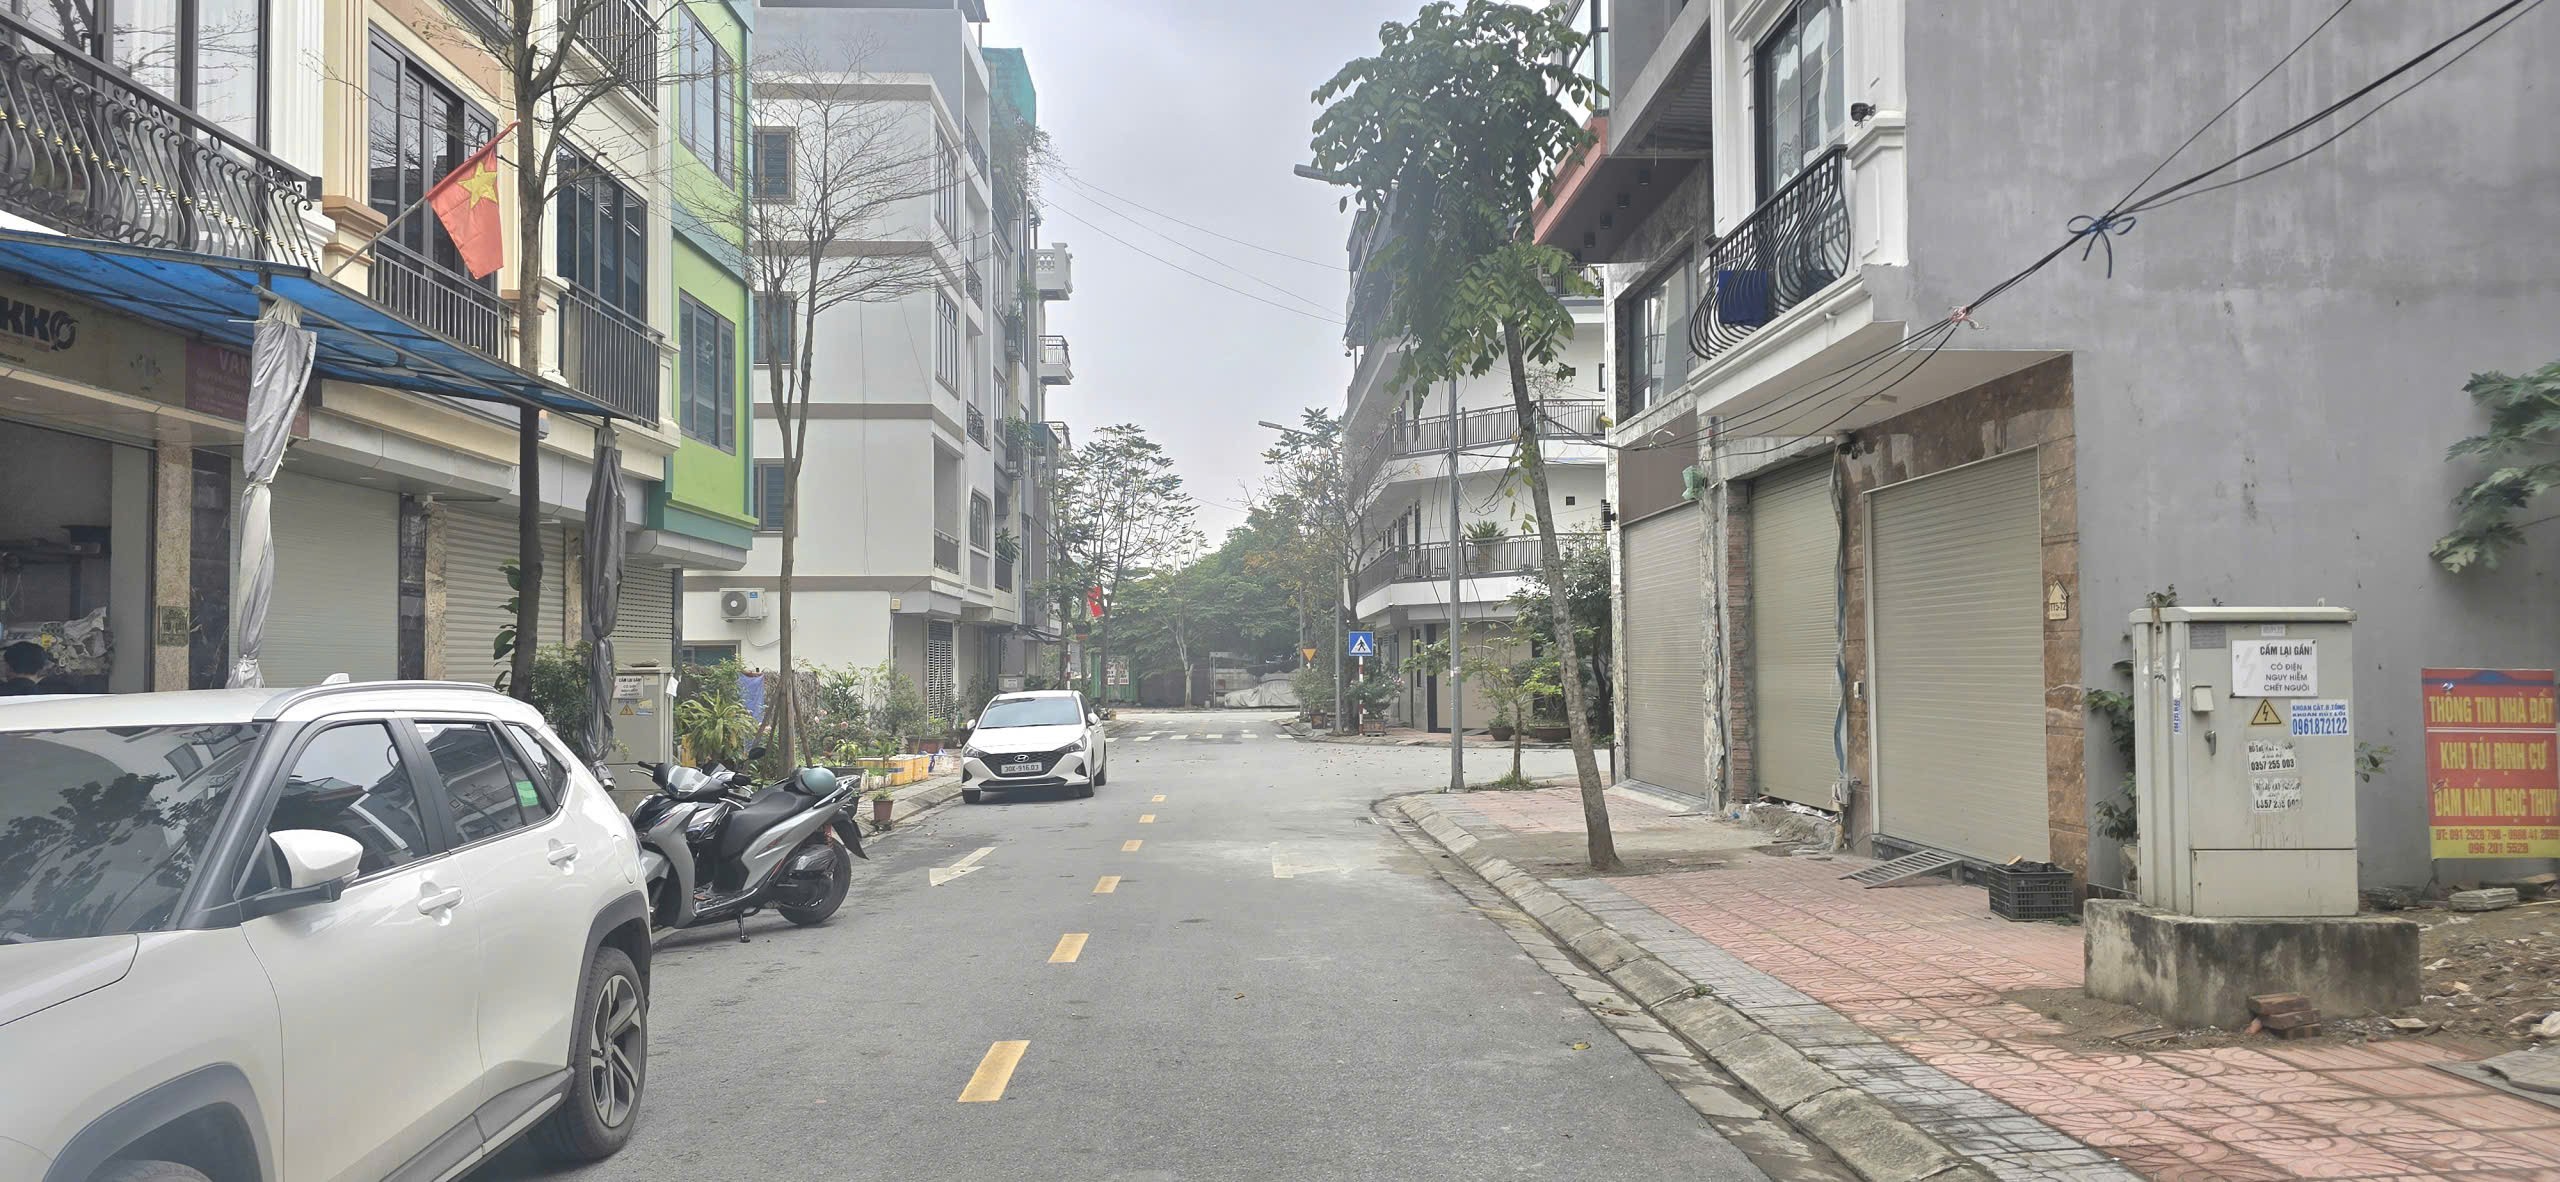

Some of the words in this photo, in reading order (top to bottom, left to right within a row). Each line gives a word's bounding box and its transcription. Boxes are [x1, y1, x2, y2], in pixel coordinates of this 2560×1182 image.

[2260, 643, 2278, 655] CẤM
[2280, 646, 2291, 657] LẠI
[2270, 662, 2283, 671] CÓ
[2429, 691, 2472, 722] THÔNG
[2475, 696, 2496, 723] TIN
[2499, 691, 2528, 723] NHÀ
[2528, 688, 2554, 724] ĐẤT
[2268, 760, 2280, 769] 255
[2440, 742, 2467, 769] KHU
[2470, 736, 2490, 769] TÁI
[2494, 742, 2525, 775] ĐỊNH
[2494, 788, 2527, 823] NGỌC
